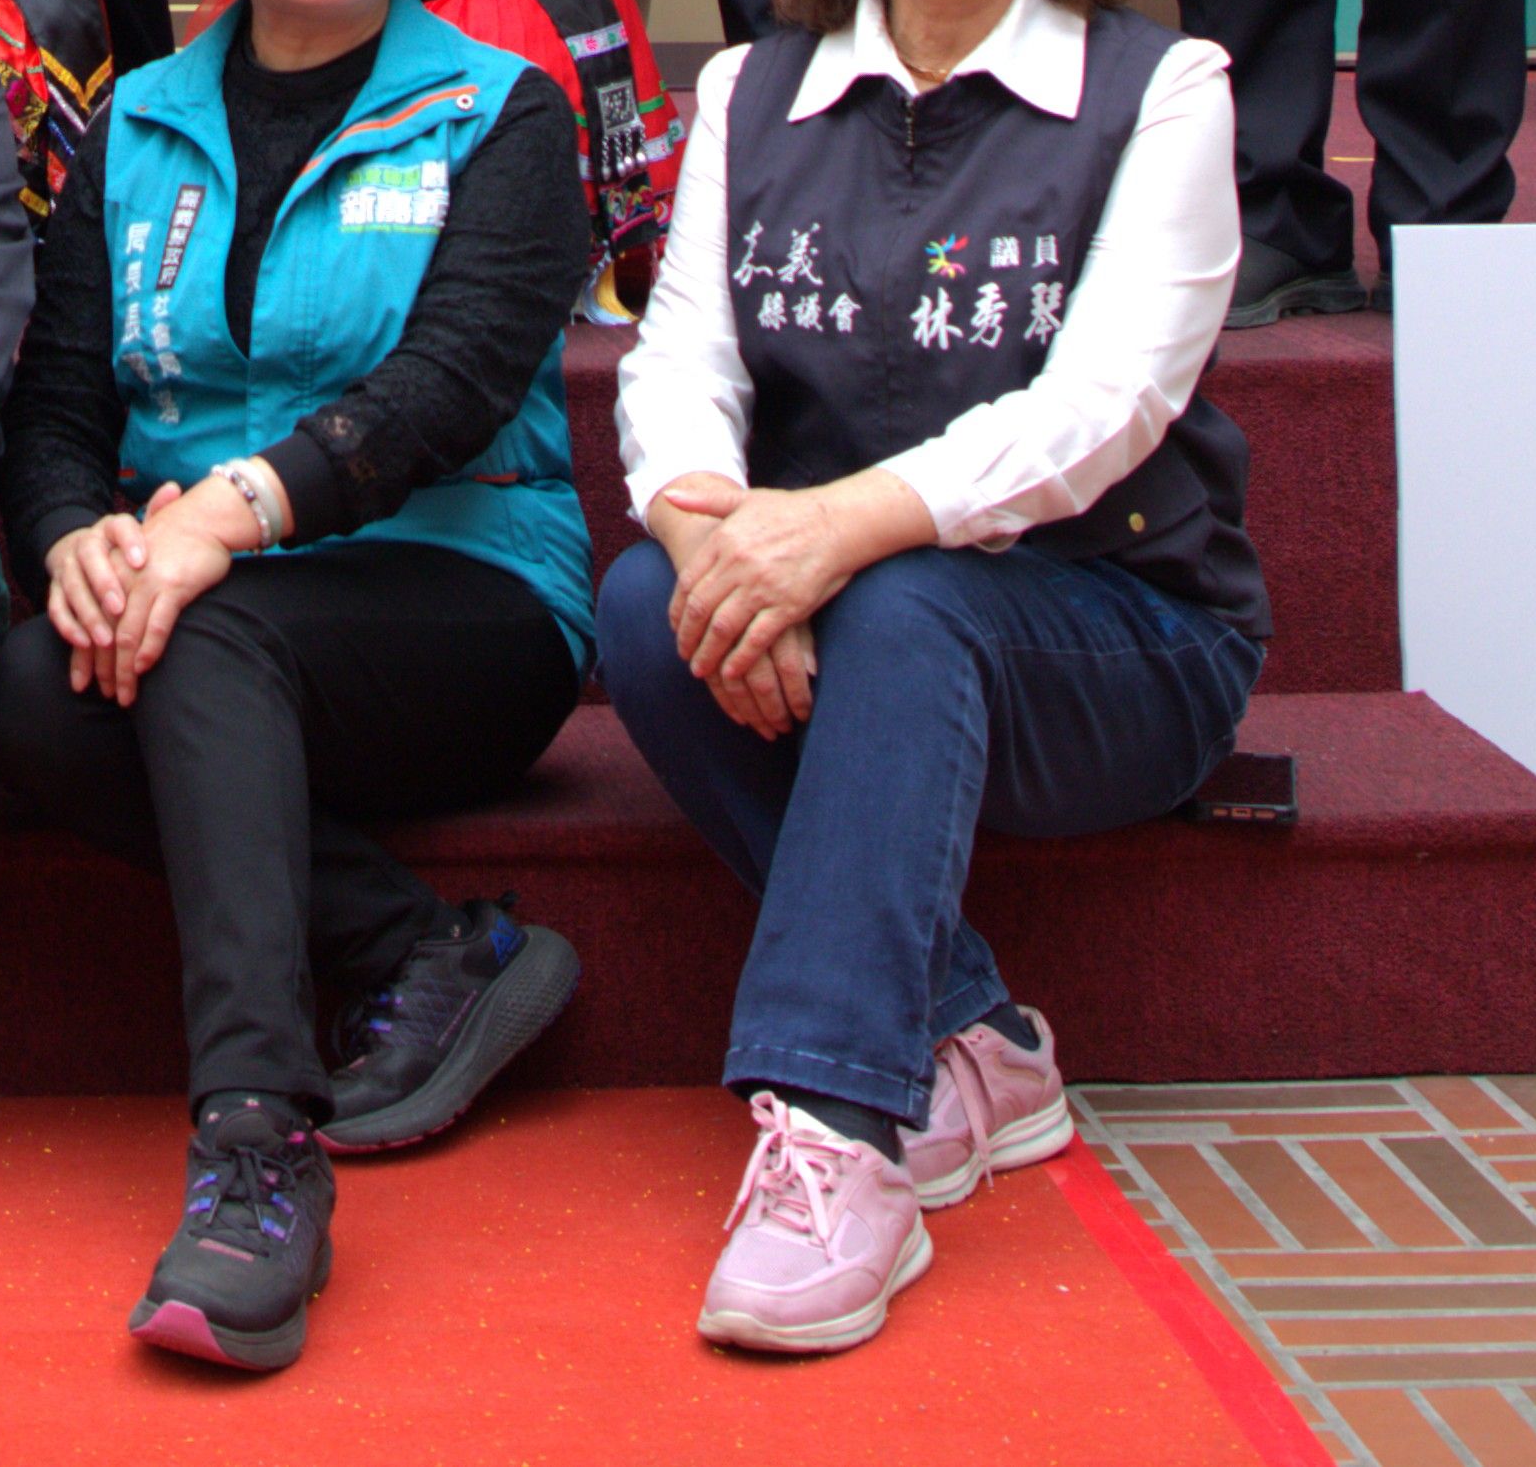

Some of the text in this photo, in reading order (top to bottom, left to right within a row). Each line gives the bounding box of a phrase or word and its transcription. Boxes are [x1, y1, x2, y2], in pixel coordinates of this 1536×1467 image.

[989, 234, 1058, 268] 議員
[910, 281, 1064, 351] 林秀琴
